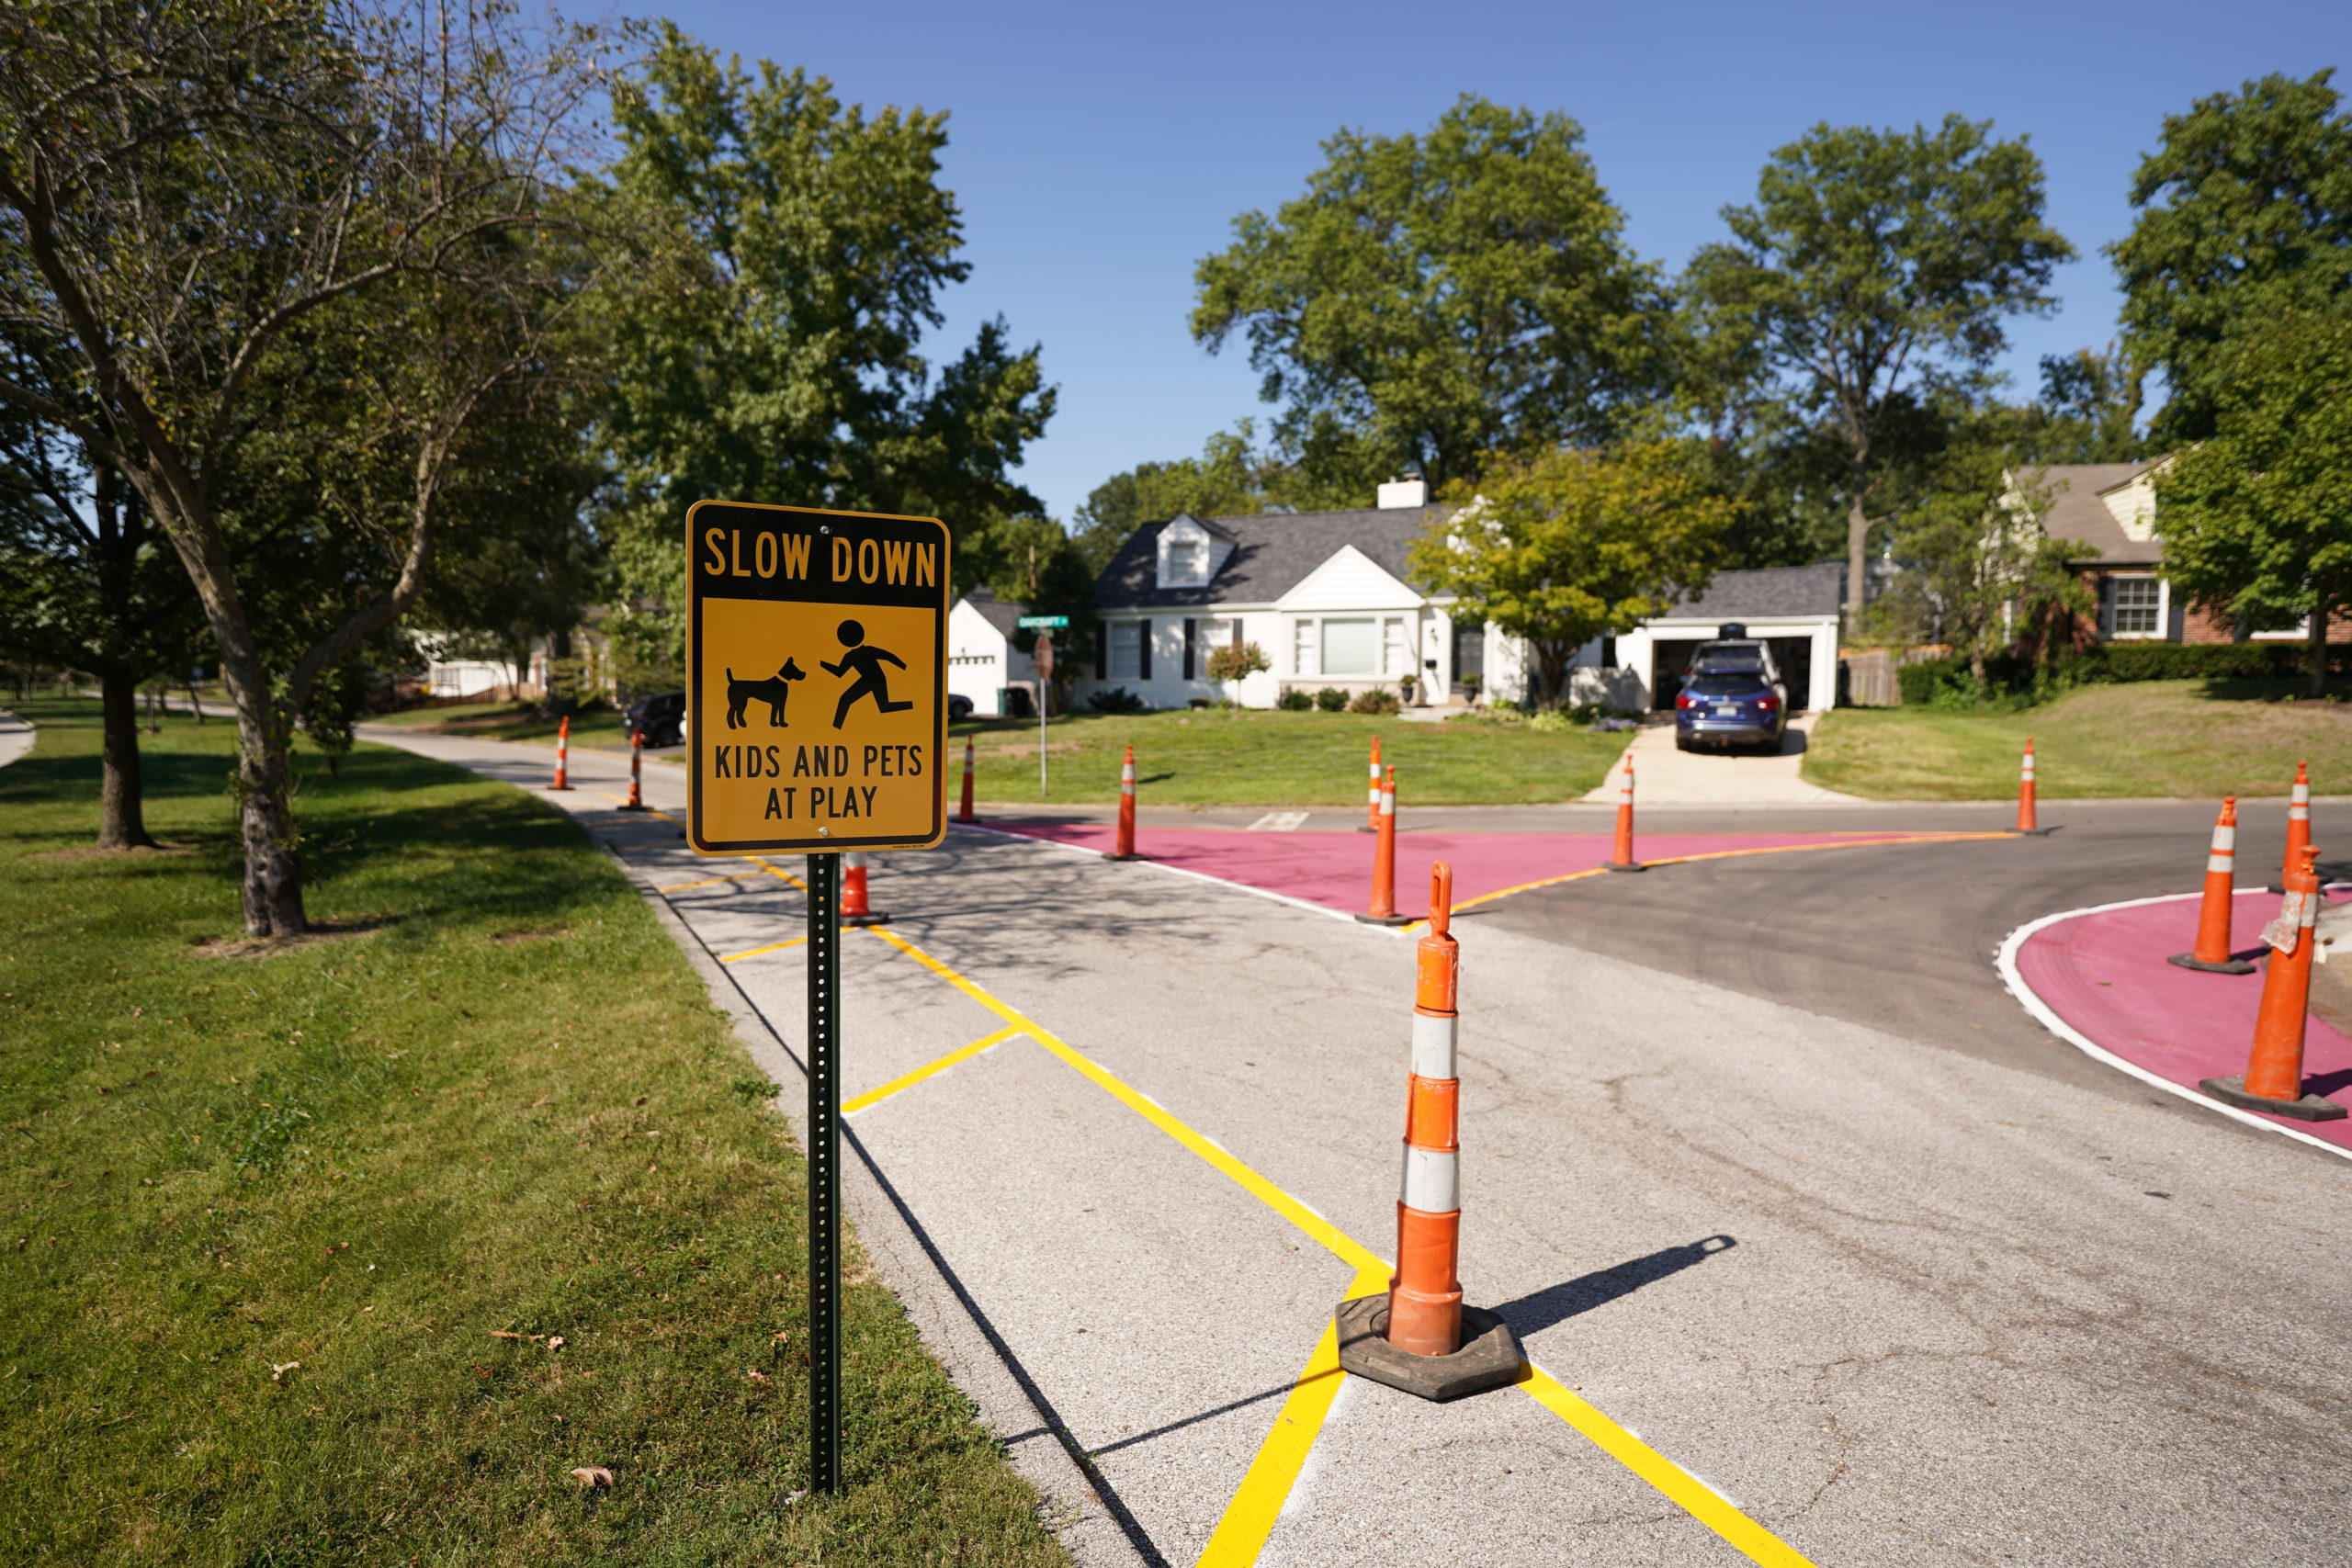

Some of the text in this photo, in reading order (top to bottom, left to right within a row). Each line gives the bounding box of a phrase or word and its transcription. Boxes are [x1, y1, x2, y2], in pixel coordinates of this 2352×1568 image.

[705, 527, 936, 588] SLOW DOWN
[715, 745, 922, 778] KIDS AND PETS
[764, 786, 877, 819] AT PLAY
